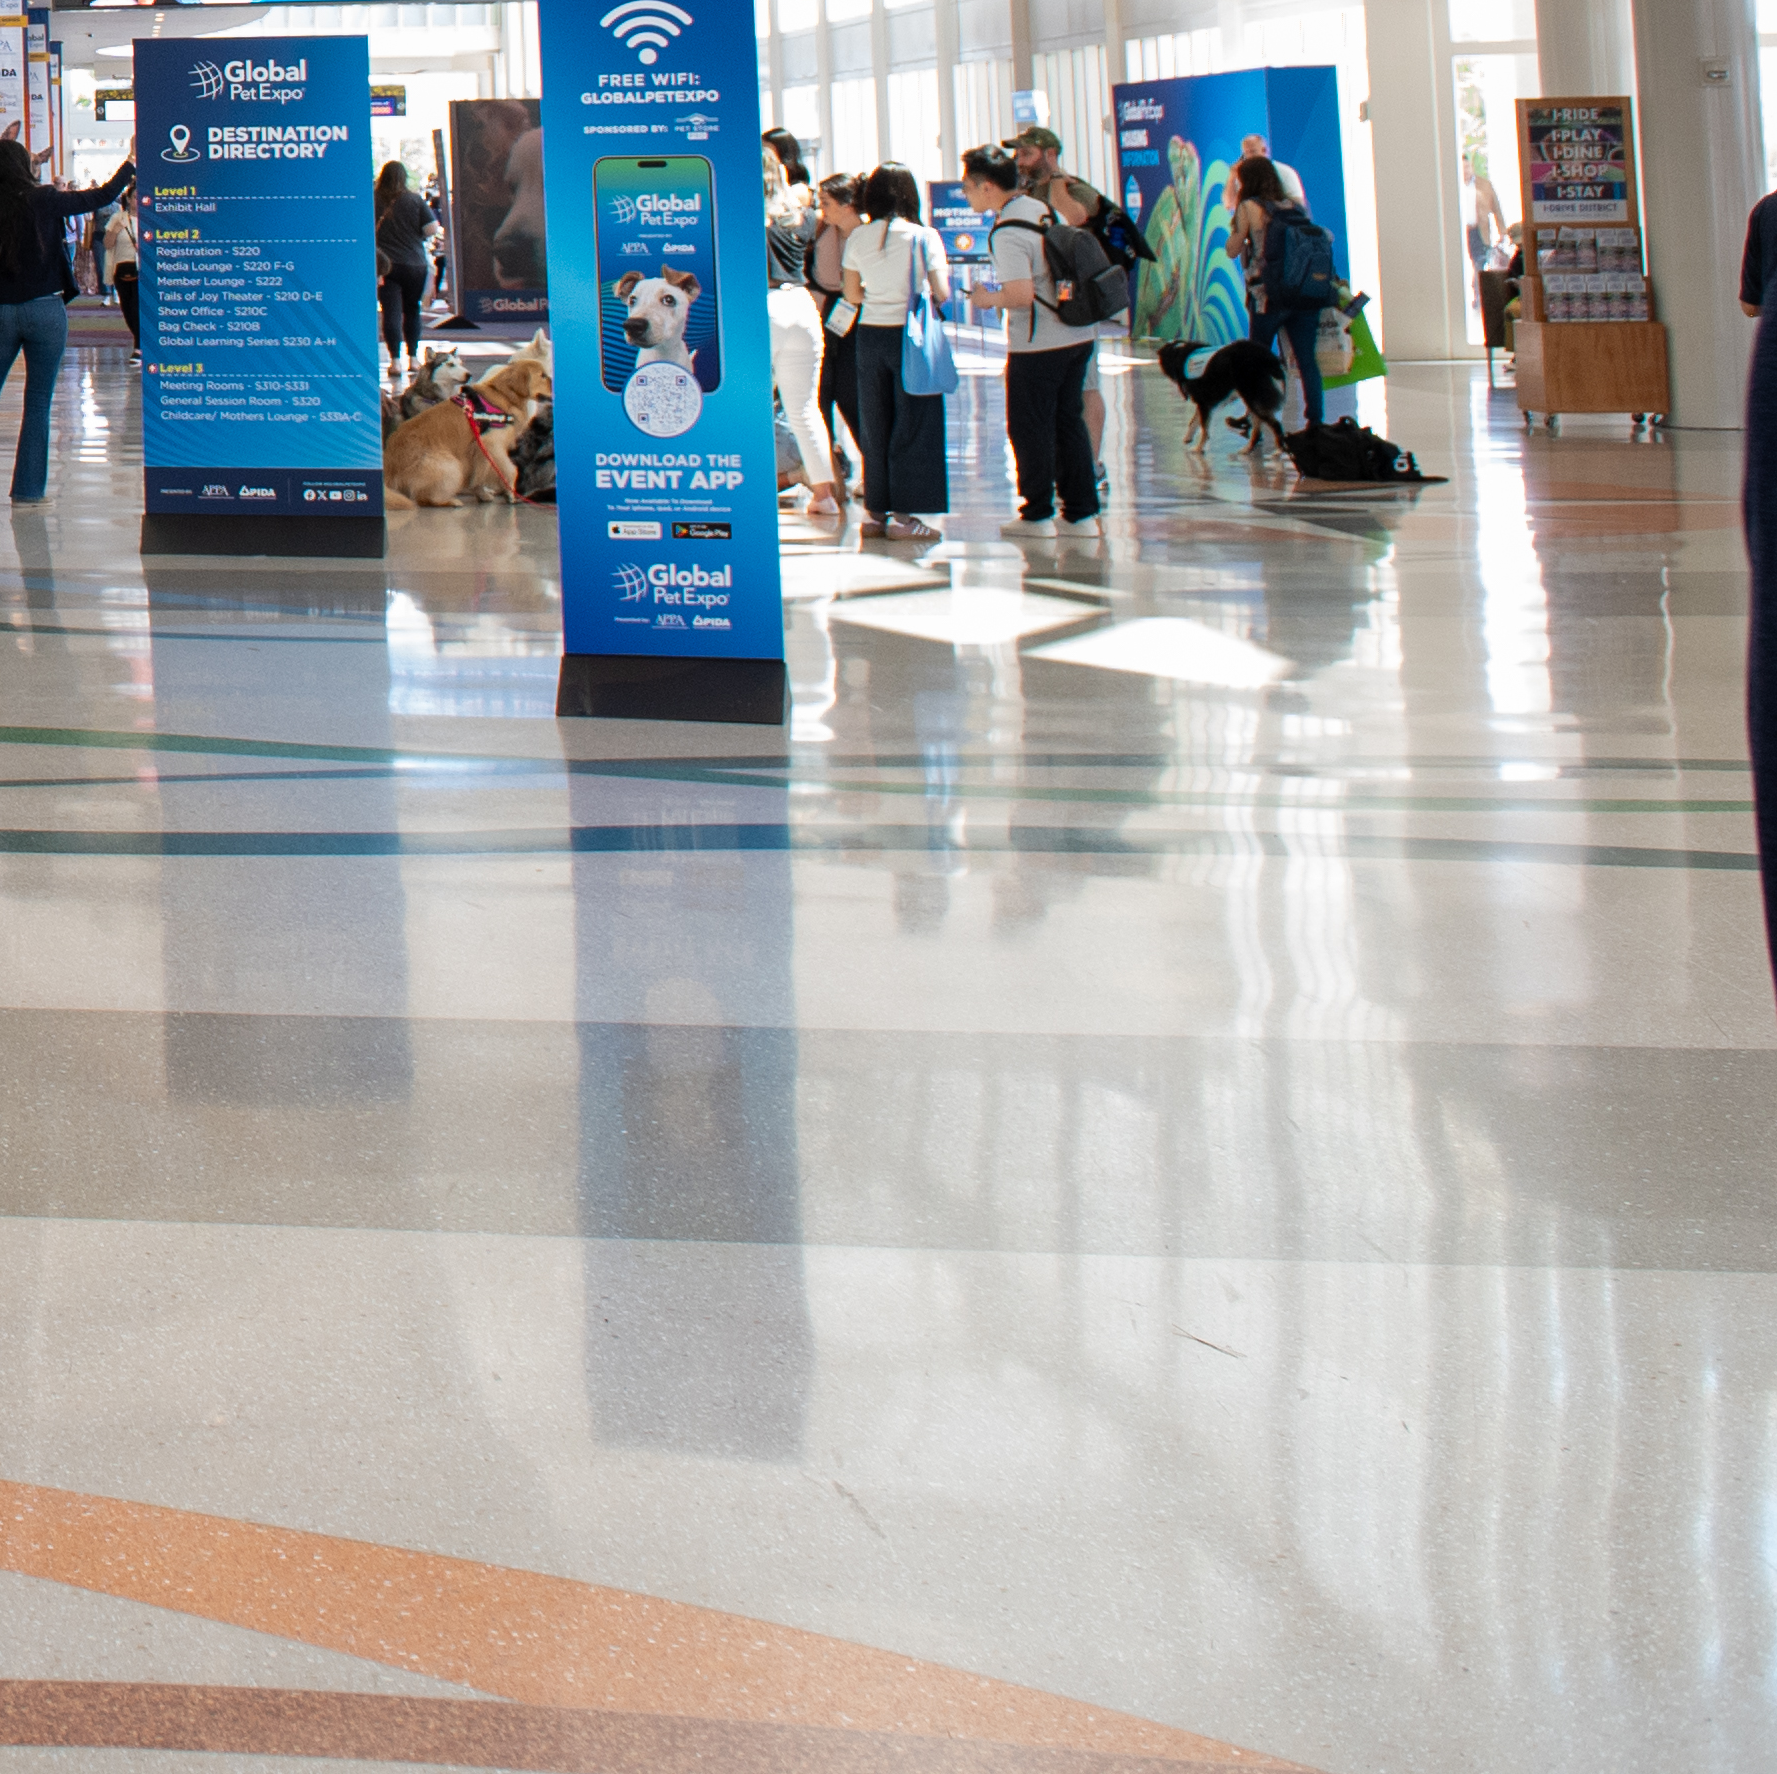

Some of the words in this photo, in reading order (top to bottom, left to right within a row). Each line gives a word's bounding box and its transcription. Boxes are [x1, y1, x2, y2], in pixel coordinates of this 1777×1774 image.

[224, 58, 307, 83] Global
[598, 73, 646, 88] FREE
[651, 72, 701, 87] WIFI:
[230, 84, 257, 101] Pet
[580, 89, 720, 105] GLOBALPETEXPO
[207, 125, 349, 142] DESTINATION
[208, 143, 329, 160] DIRECTORY
[154, 186, 188, 197] Level
[189, 186, 196, 197] 1
[155, 202, 193, 213] Exhibit
[195, 202, 217, 213] Hall
[636, 193, 701, 212] Global
[640, 211, 662, 226] Pet
[155, 229, 189, 240] Level
[192, 229, 200, 240] 2
[156, 246, 223, 257] Registration
[232, 246, 261, 256] S220
[156, 261, 189, 272] Media
[191, 261, 233, 273] Lounge
[243, 261, 272, 271] S220
[157, 276, 202, 286] Member
[203, 276, 245, 288] Lounge
[255, 276, 283, 286] S222
[158, 291, 182, 301] Tails
[184, 291, 197, 301] of
[198, 291, 219, 303] Joy
[221, 291, 264, 301] Theater
[273, 291, 300, 301] S210
[157, 306, 189, 316] Show
[190, 306, 225, 316] Office
[158, 321, 181, 333] Bag
[182, 321, 217, 331] Check
[158, 336, 194, 346] Global
[196, 336, 244, 348] Learning
[246, 336, 281, 346] Series
[159, 363, 193, 373] Level
[195, 363, 204, 373] 3
[160, 381, 204, 392] Meeting
[206, 381, 245, 391] Rooms
[160, 395, 203, 406] General
[205, 396, 246, 406] Session
[248, 396, 283, 406] Room
[220, 411, 265, 421] Mothers
[267, 411, 309, 423] Lounge
[595, 453, 702, 468] DOWNLOAD
[706, 454, 742, 469] THE
[595, 470, 683, 489] EVENT
[689, 471, 744, 490] APP
[647, 564, 732, 587] Global
[653, 587, 682, 605] Pet
